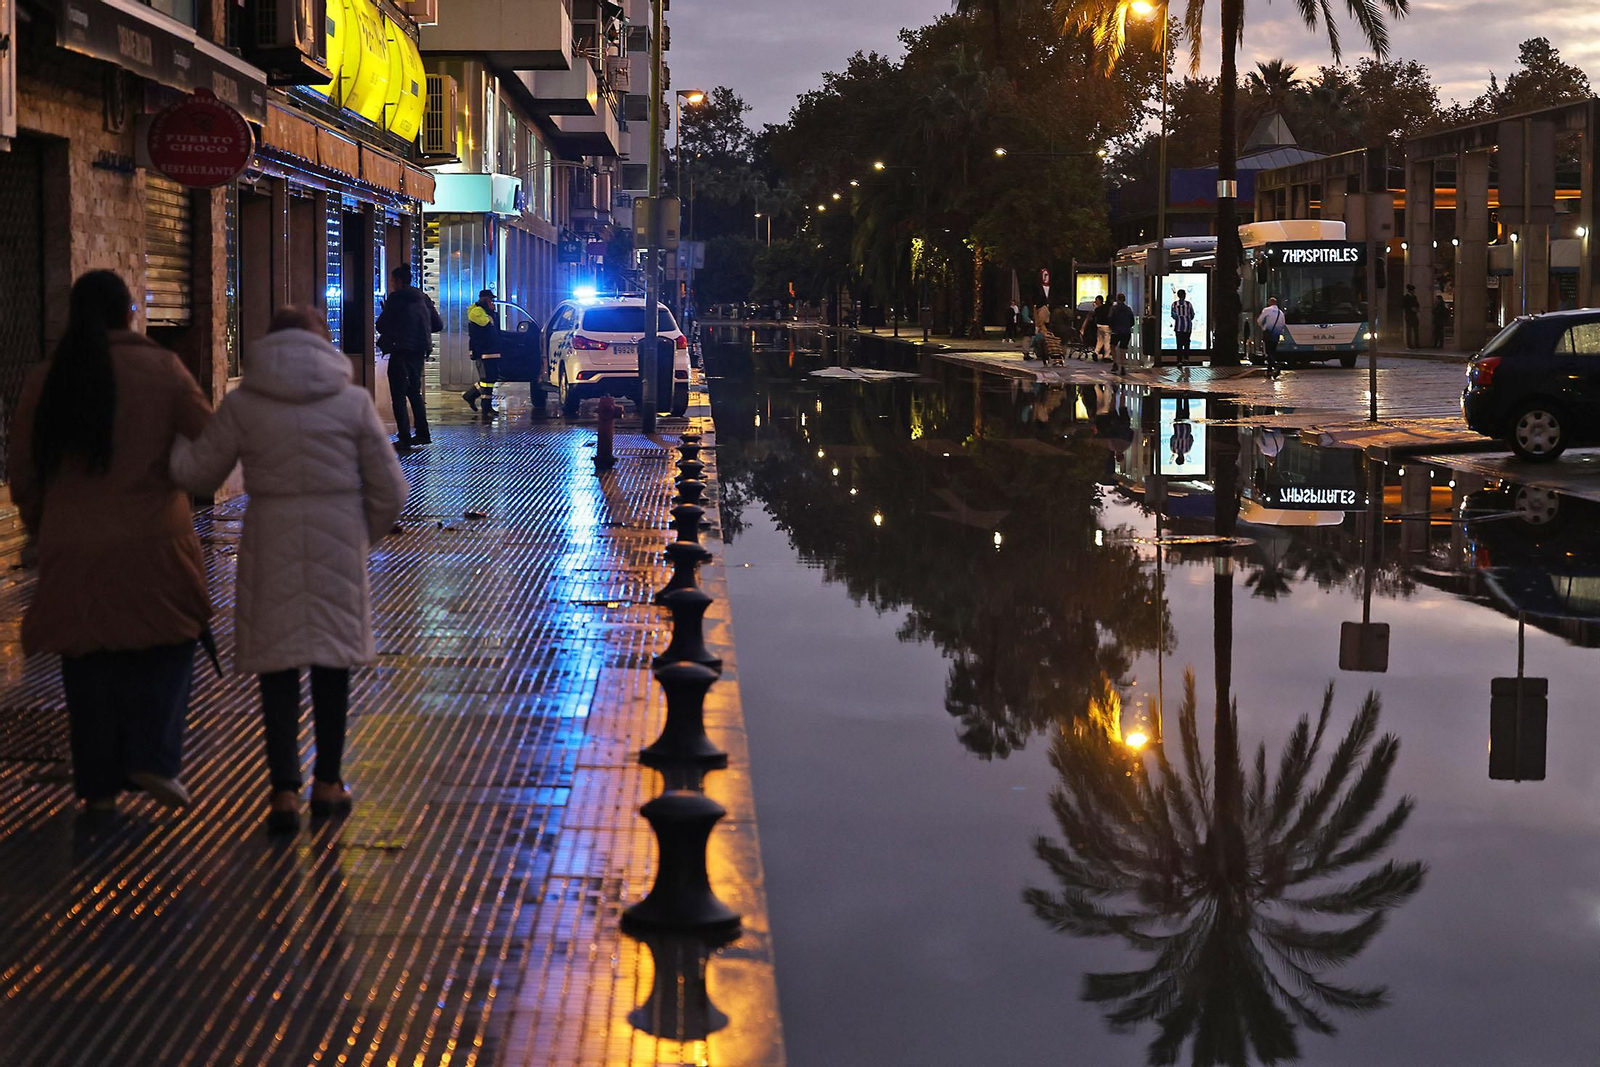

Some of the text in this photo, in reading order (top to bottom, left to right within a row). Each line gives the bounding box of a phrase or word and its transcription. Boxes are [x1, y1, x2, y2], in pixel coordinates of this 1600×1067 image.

[166, 134, 233, 145] PUERTO
[169, 144, 229, 153] CHOCO
[160, 163, 236, 176] RESTAURANTE
